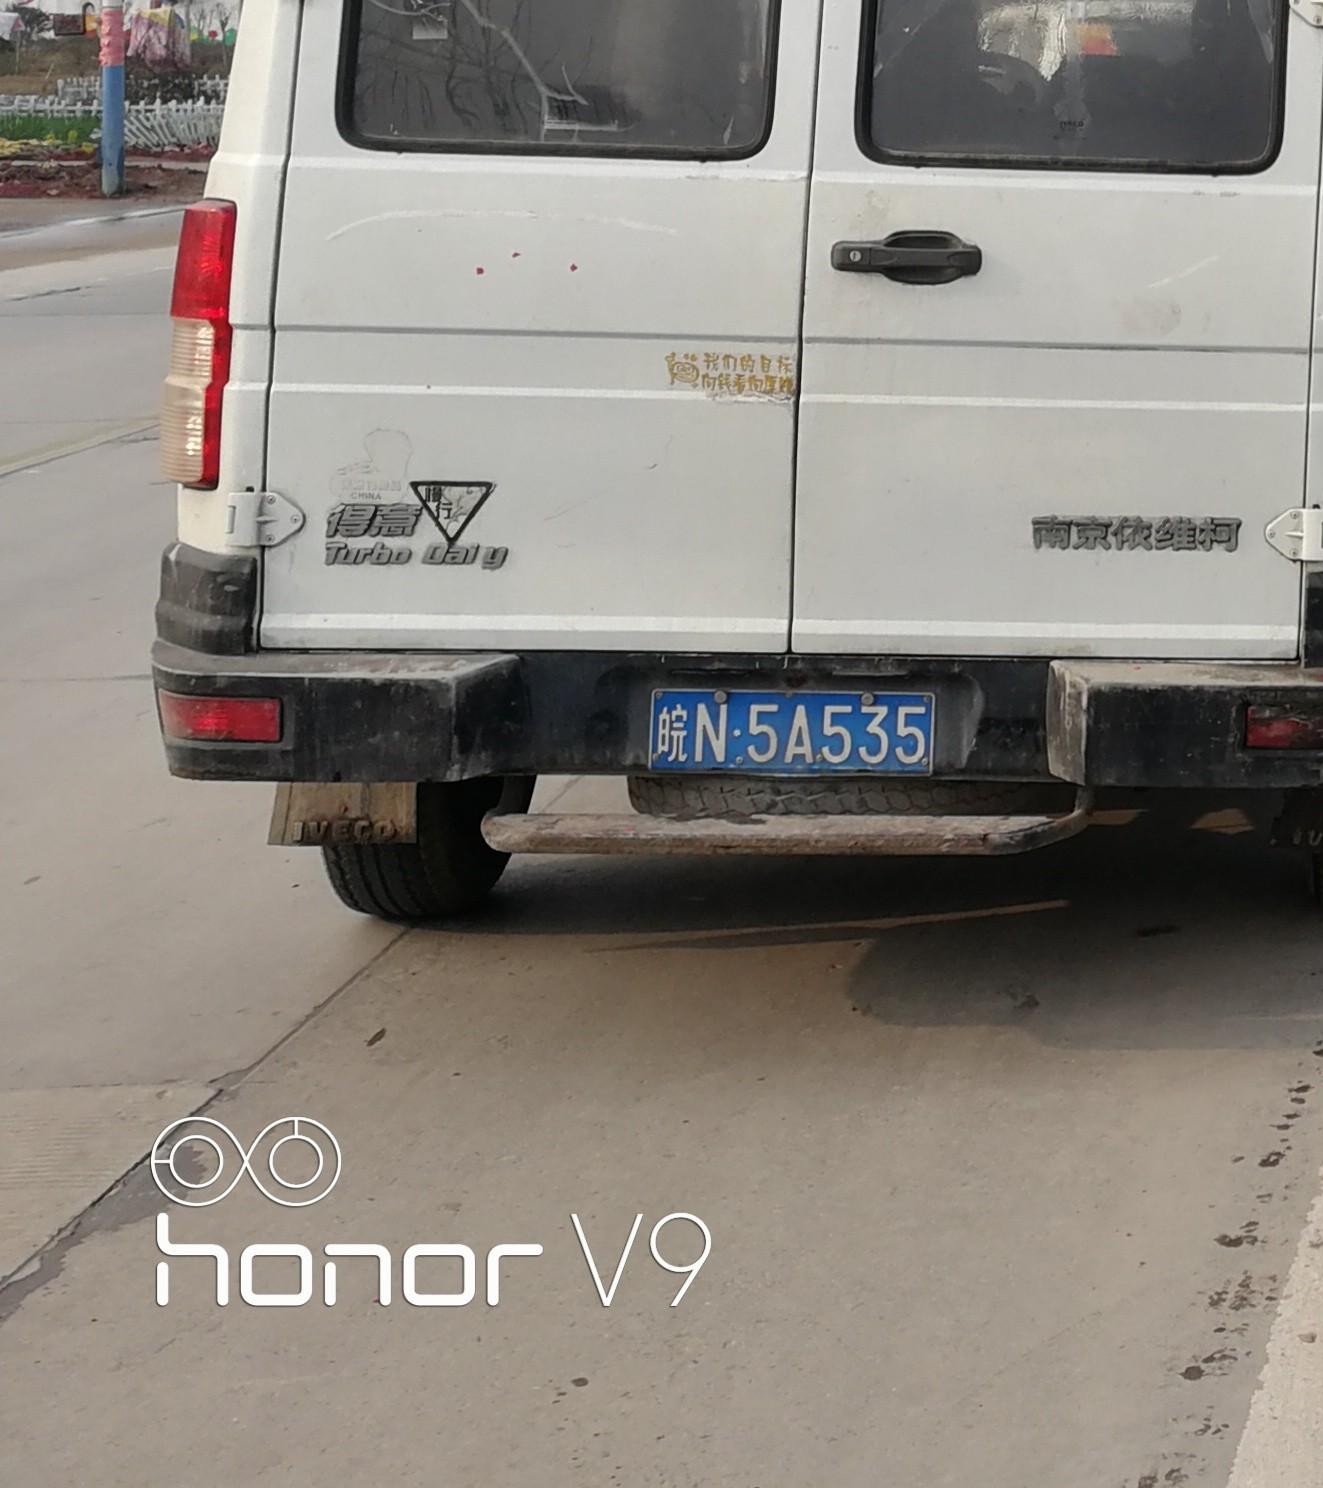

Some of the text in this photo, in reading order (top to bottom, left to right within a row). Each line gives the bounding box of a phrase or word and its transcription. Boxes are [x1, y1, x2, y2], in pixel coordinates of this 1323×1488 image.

[351, 491, 382, 500] CHINA
[326, 502, 423, 537] 得意
[1031, 514, 1242, 552] 南京依维柯
[325, 542, 412, 566] Turbo
[292, 820, 398, 842] IVECO
